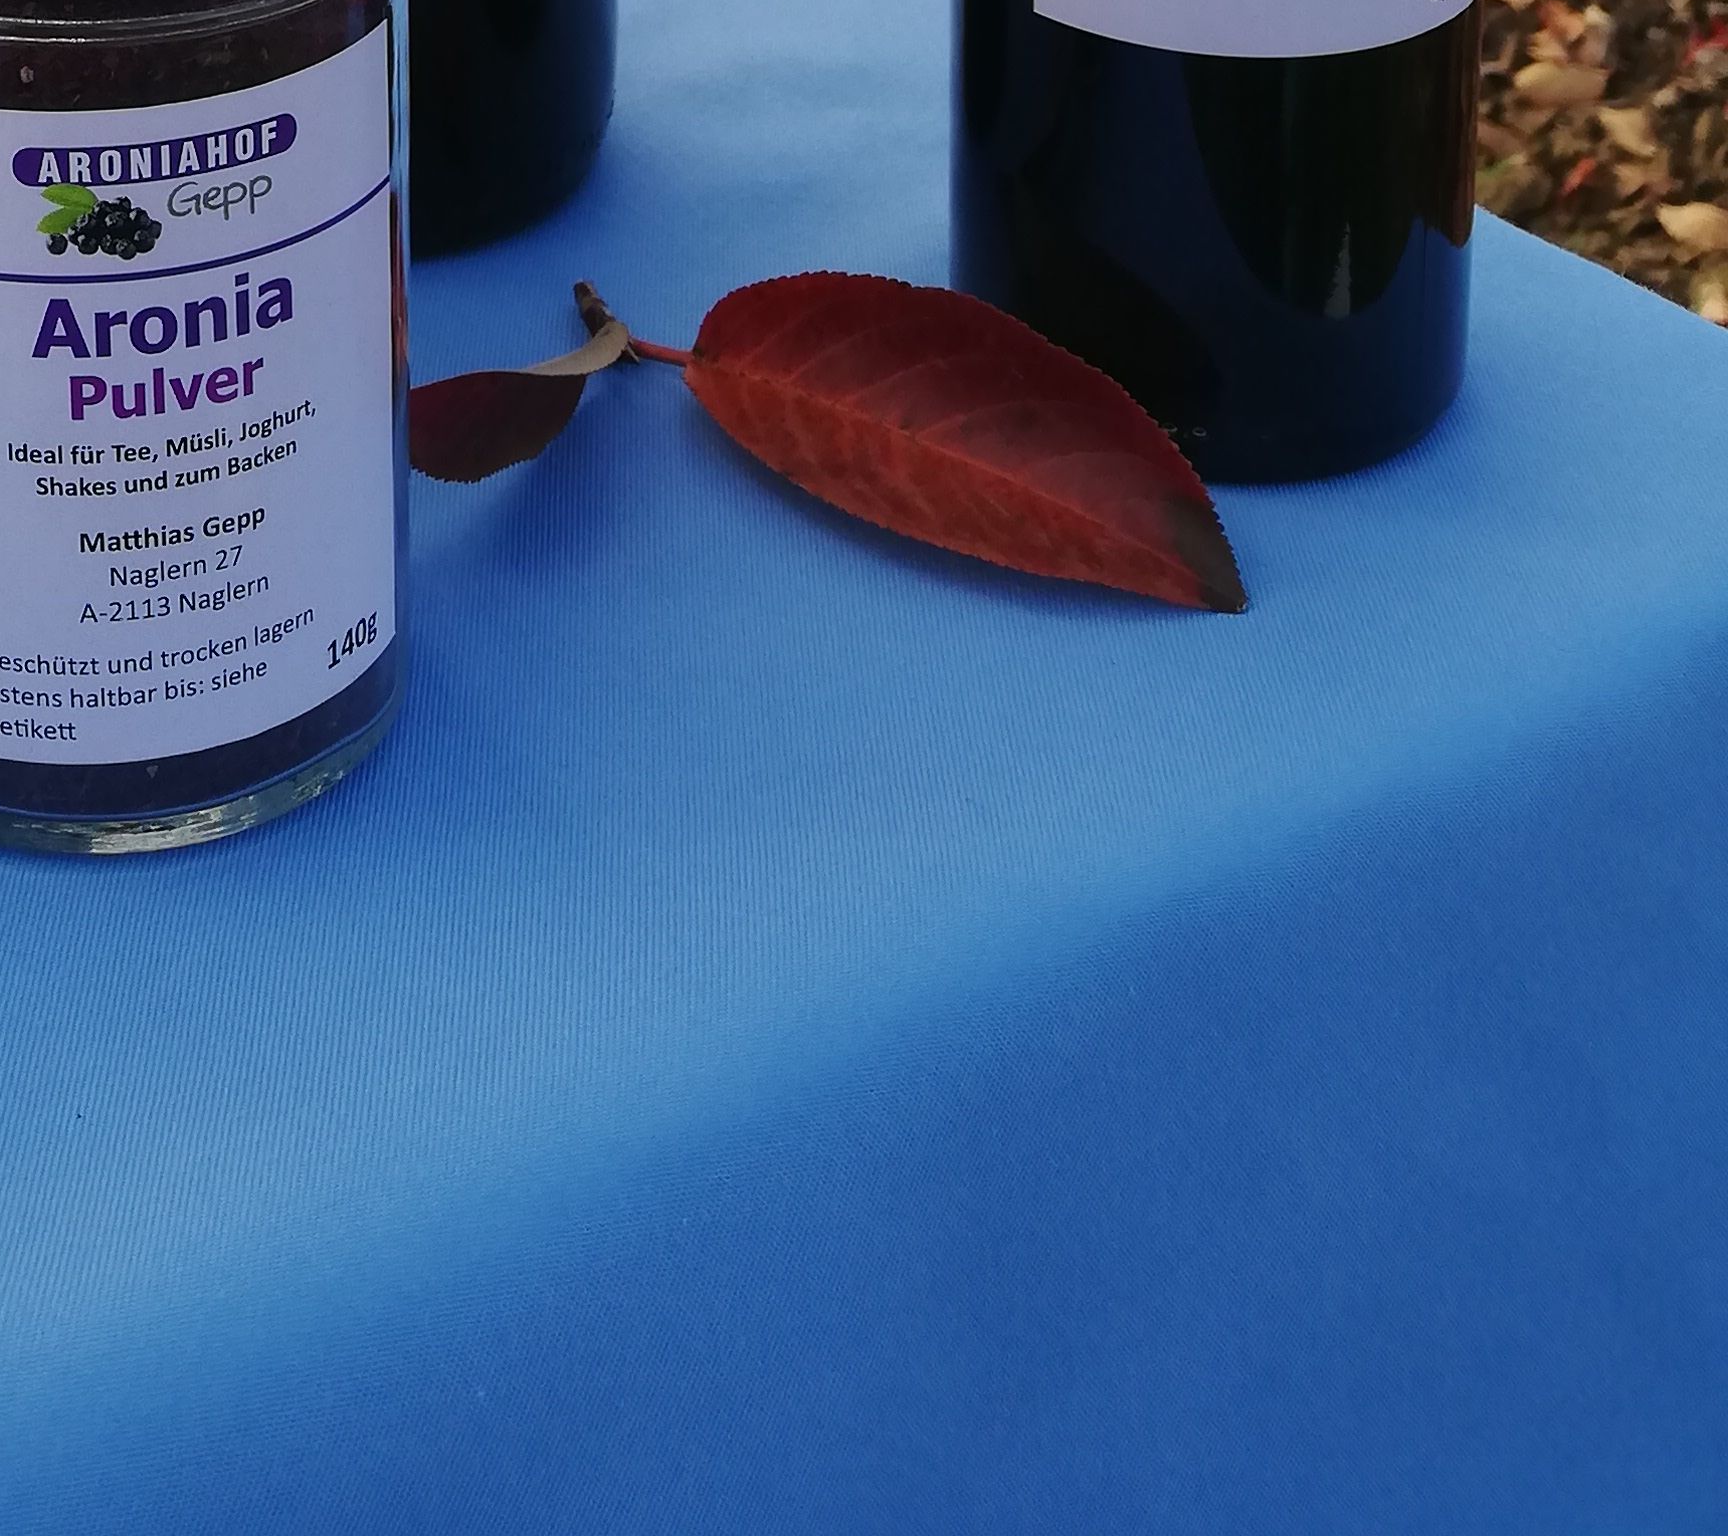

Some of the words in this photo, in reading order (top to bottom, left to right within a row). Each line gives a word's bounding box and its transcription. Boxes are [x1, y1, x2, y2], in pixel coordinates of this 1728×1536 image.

[37, 119, 278, 185] ARONIAHOF
[166, 174, 273, 221] Gepp
[31, 271, 295, 360] Aronia
[68, 356, 264, 422] Pulver
[7, 441, 64, 465] Ideal
[70, 443, 105, 466] für
[112, 441, 159, 465] Tee,
[165, 427, 235, 459] Müsli,
[238, 398, 317, 444] Joghurt,
[35, 475, 118, 498] Shakes
[124, 471, 168, 495] und
[175, 464, 221, 488] zum
[227, 437, 298, 477] Backen
[79, 524, 195, 554] Matthias
[202, 505, 267, 540] Gepp
[109, 557, 208, 591] Naglern
[215, 545, 244, 571] 27
[79, 597, 172, 625] A-2113
[179, 573, 270, 616] Naglern
[108, 650, 154, 674] und
[160, 633, 248, 670] trocken
[254, 606, 315, 650] lagern
[326, 611, 379, 671] 140g
[70, 685, 158, 710] haltbar
[165, 675, 205, 703] bis:
[211, 658, 269, 693] siehe
